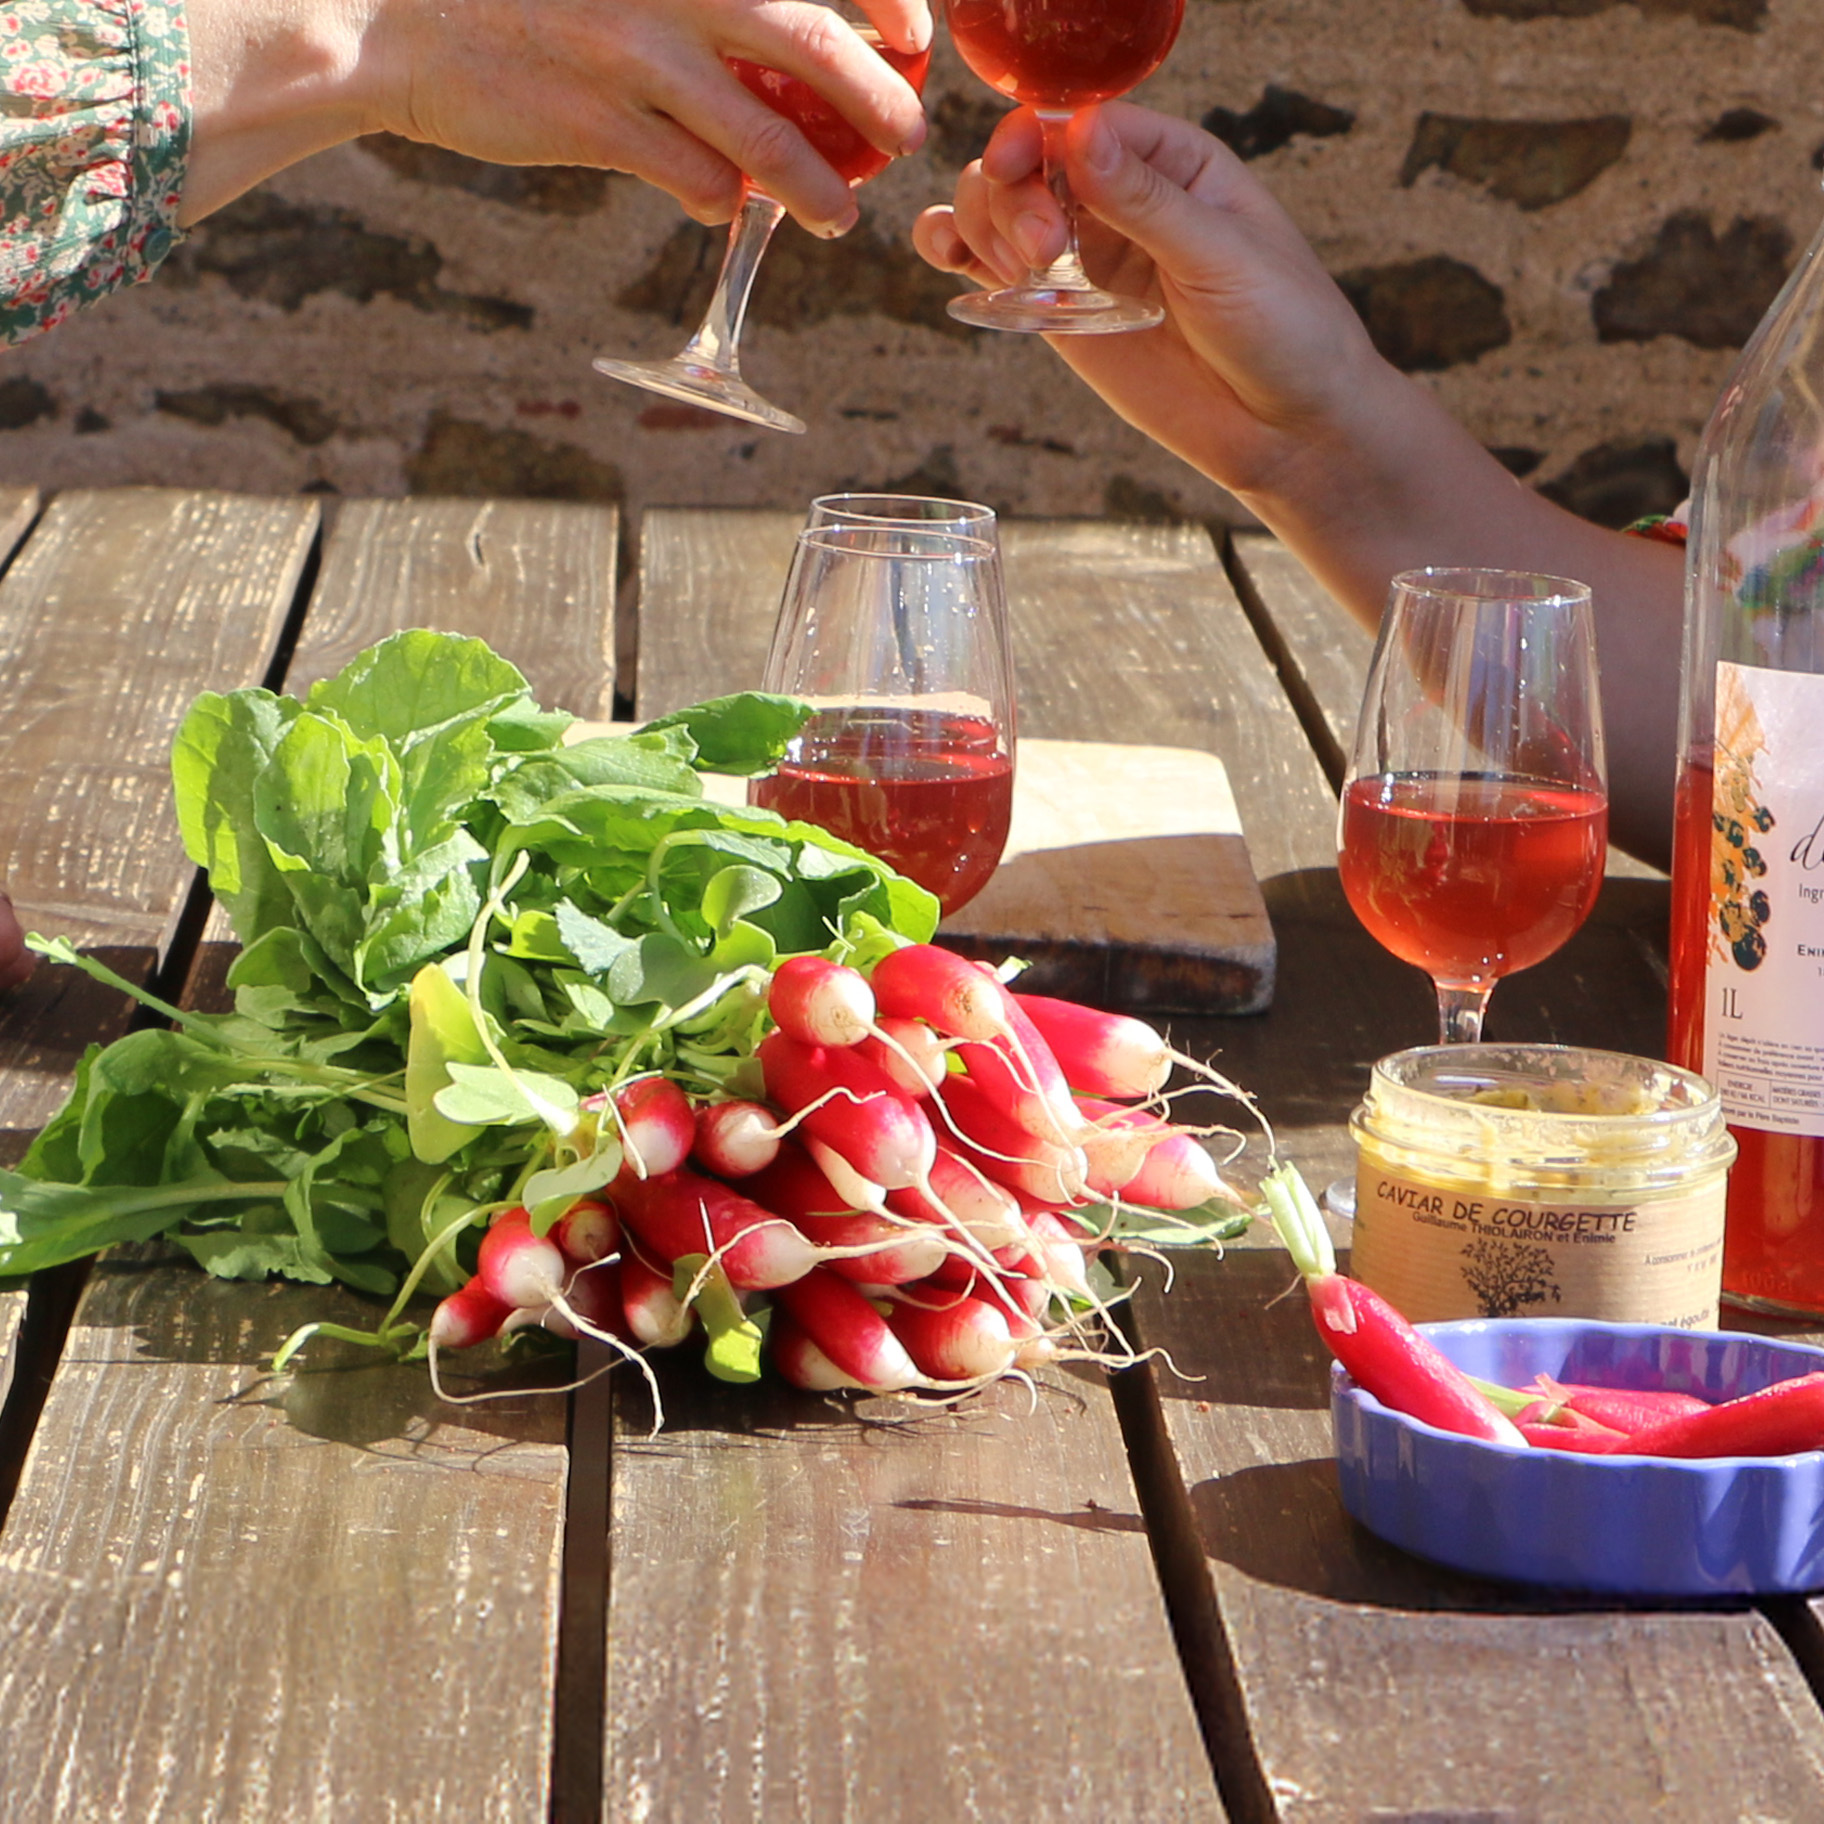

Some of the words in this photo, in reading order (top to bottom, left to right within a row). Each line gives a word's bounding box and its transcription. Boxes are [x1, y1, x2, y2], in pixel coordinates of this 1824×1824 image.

[1721, 987, 1743, 1019] 1L
[1377, 1181, 1444, 1215] CAVIAR
[1453, 1201, 1484, 1223] DE
[1492, 1207, 1637, 1233] COURGETTE
[1412, 1210, 1467, 1233] Guillaume
[1471, 1222, 1553, 1243] THIOLAIRON
[1557, 1232, 1569, 1243] et
